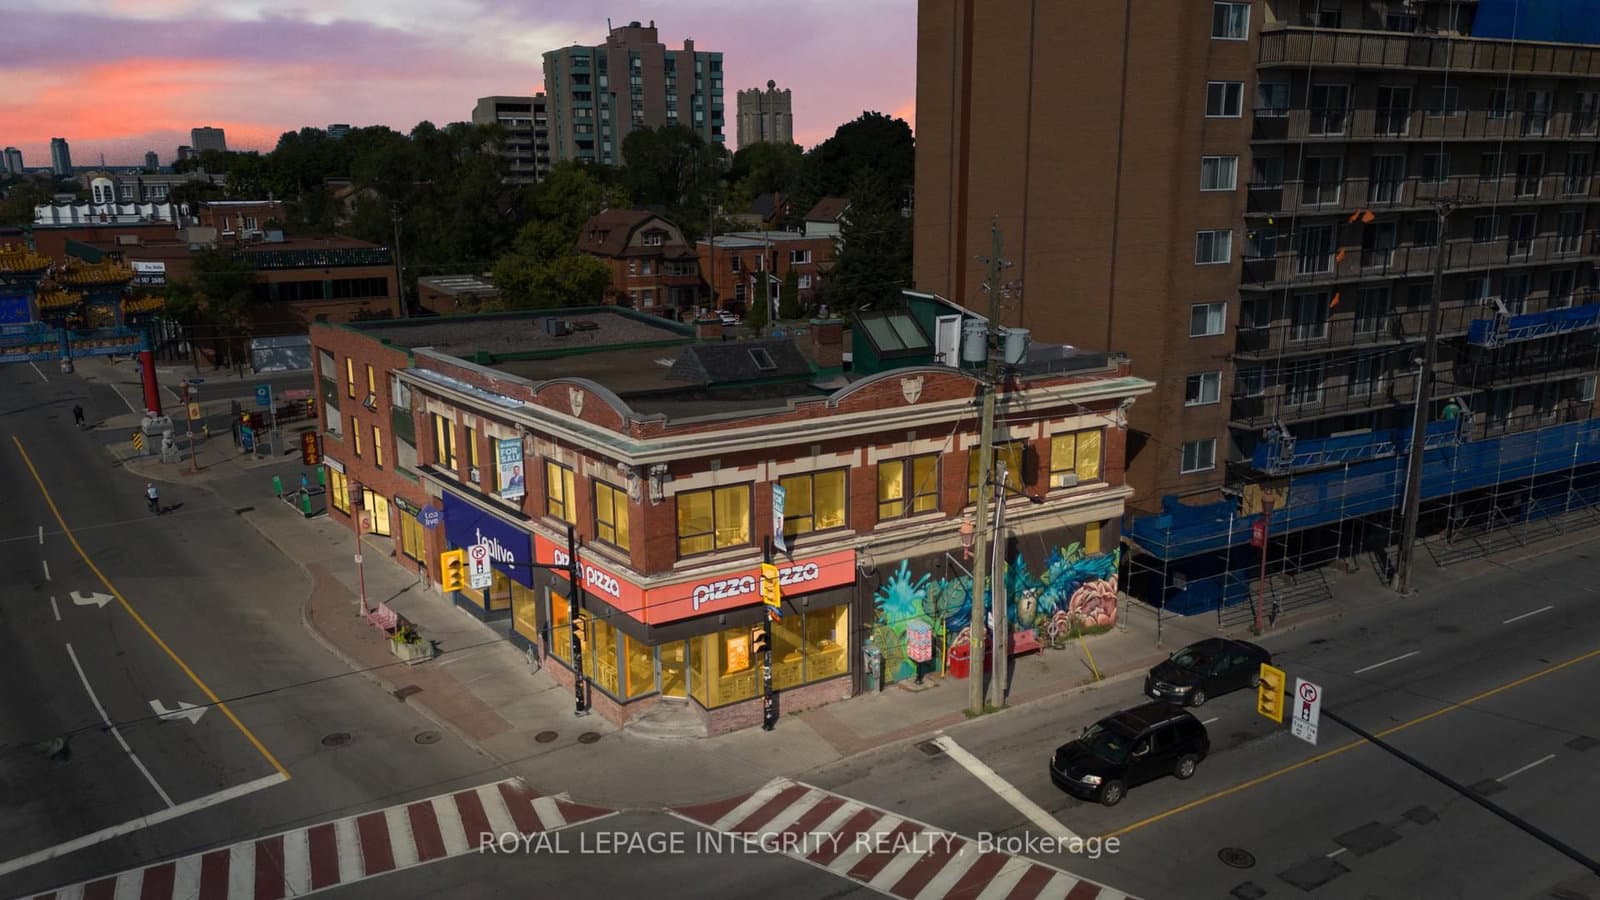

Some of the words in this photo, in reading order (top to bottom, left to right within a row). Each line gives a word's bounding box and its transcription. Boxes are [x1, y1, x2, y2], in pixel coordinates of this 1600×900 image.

[501, 447, 518, 457] FOR
[501, 454, 520, 463] SALE
[424, 511, 439, 519] tea
[425, 518, 439, 526] live
[586, 565, 620, 598] pizza
[692, 575, 756, 611] pizza
